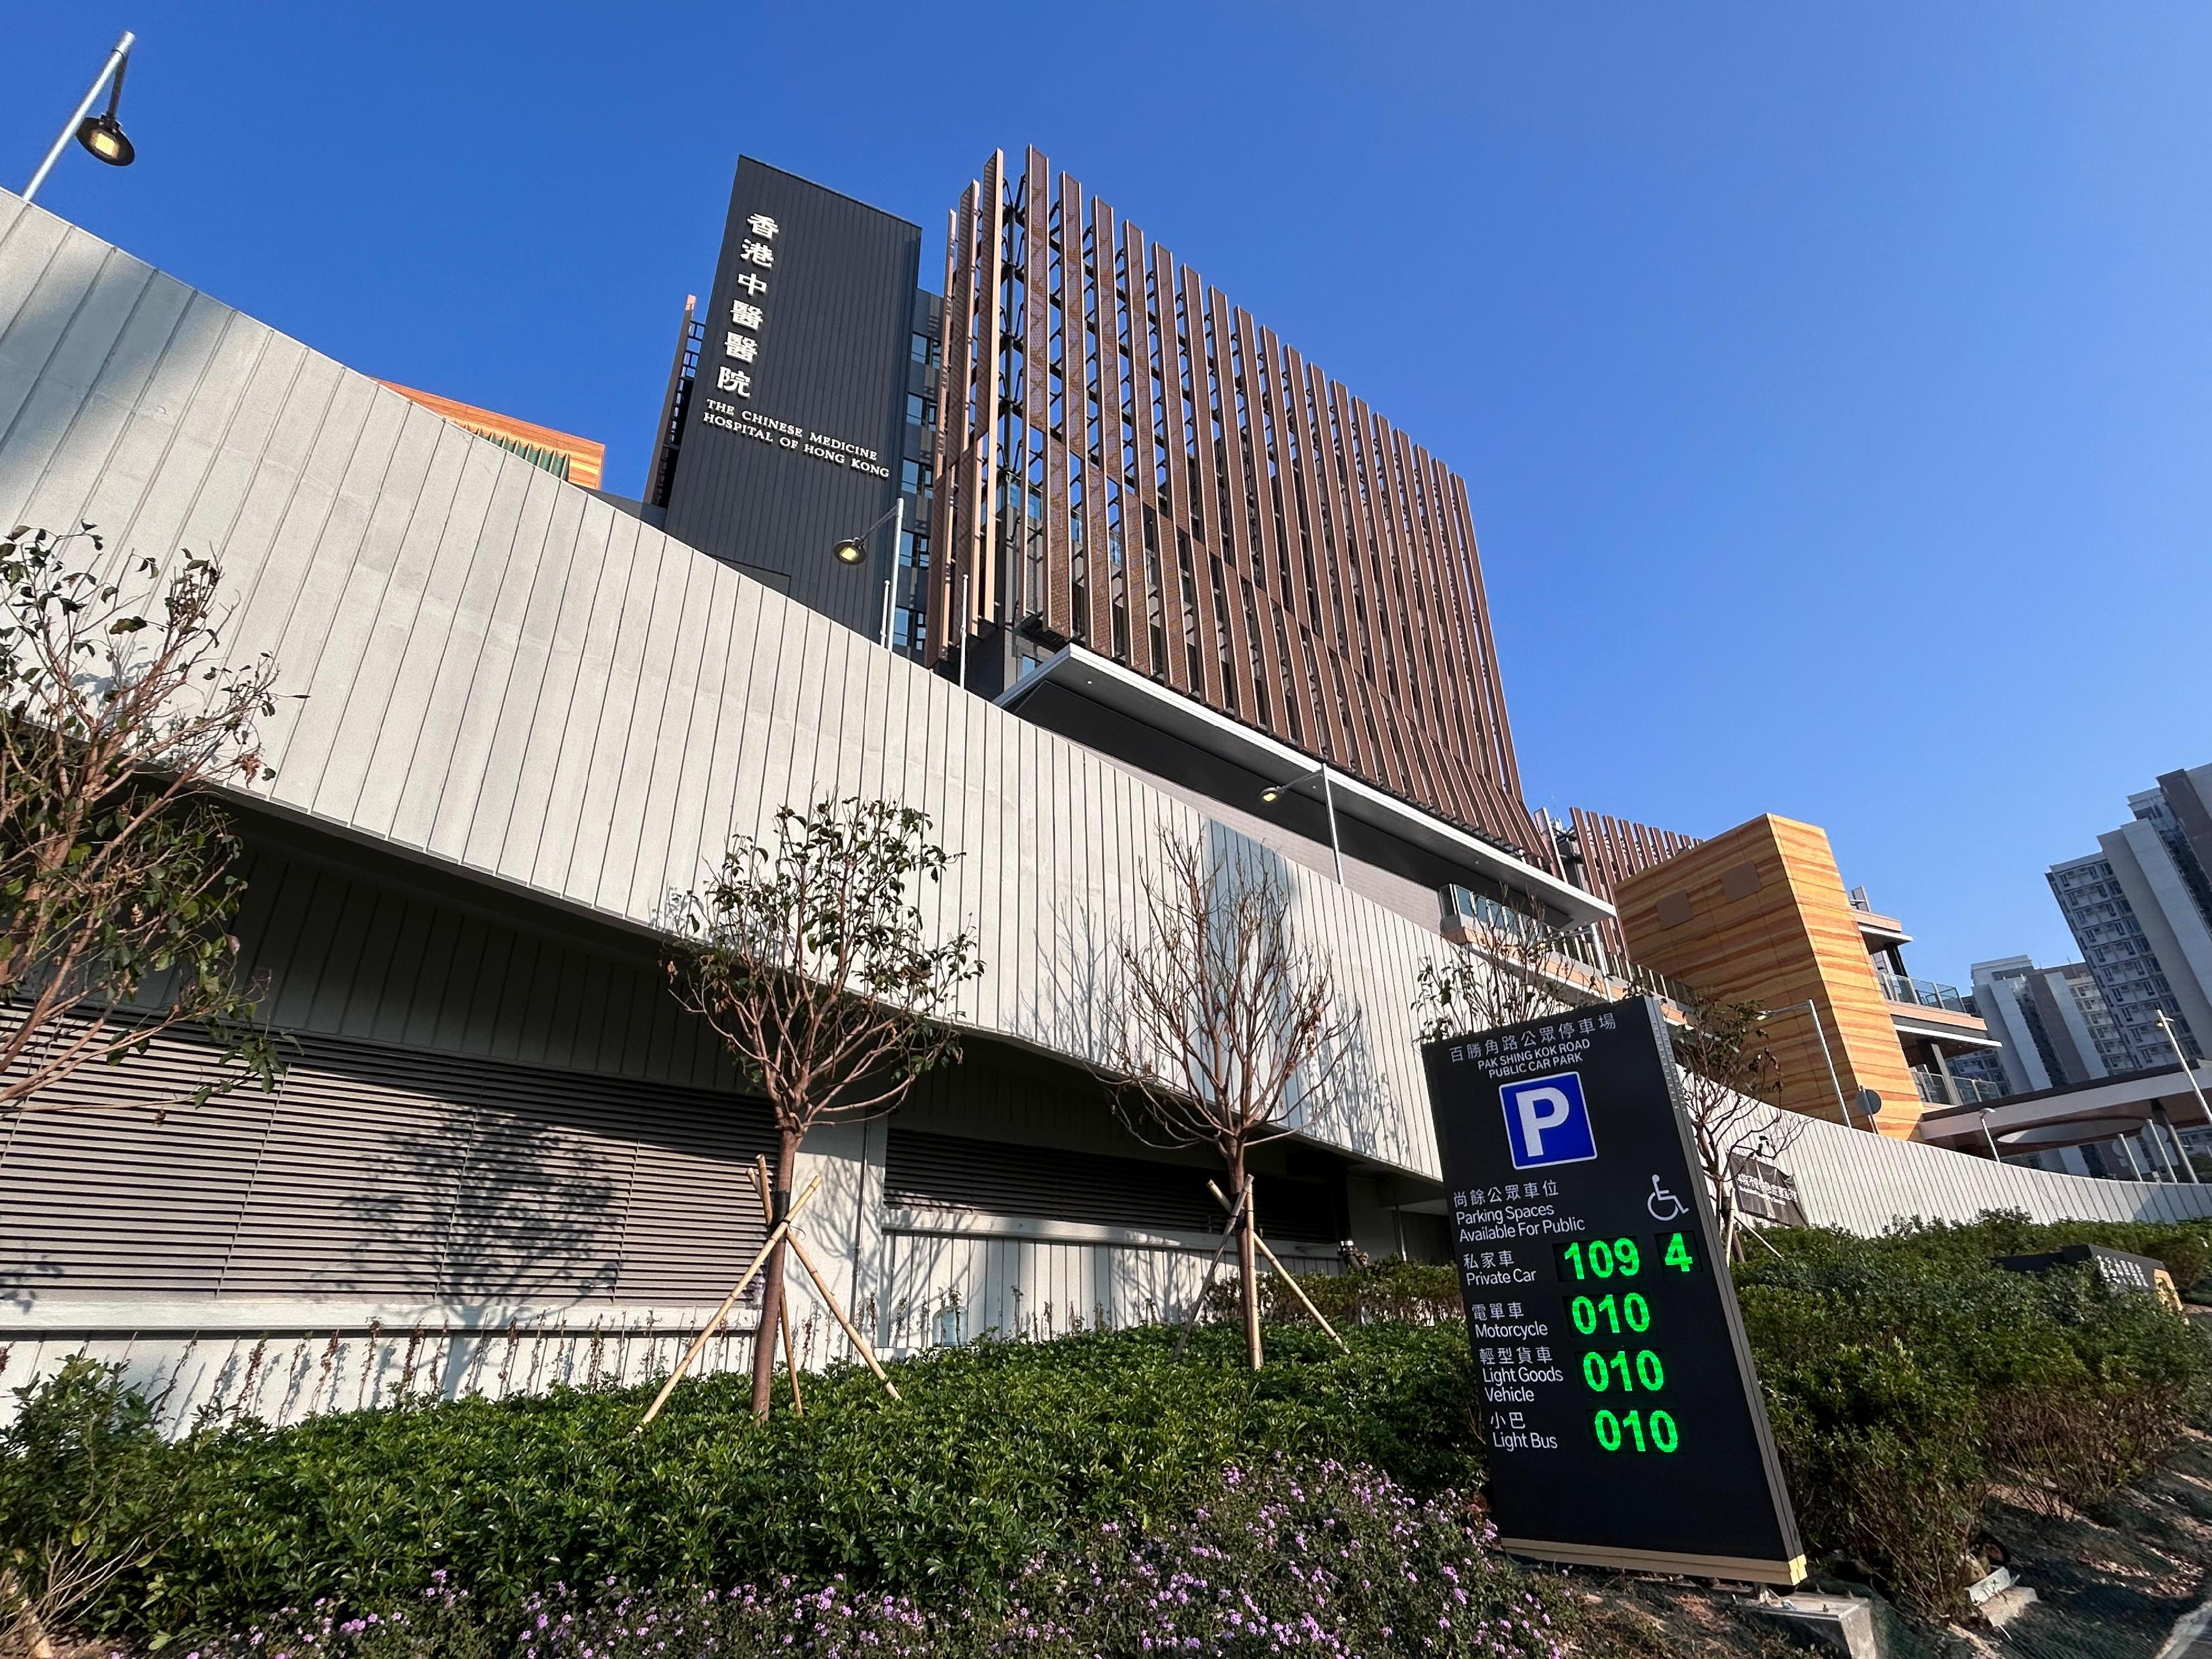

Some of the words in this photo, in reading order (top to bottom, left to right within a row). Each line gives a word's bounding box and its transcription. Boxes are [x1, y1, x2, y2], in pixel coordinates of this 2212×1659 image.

[717, 213, 779, 398] 香港中醫醫院
[707, 398, 735, 415] THE
[742, 411, 802, 437] CHINESE
[810, 432, 877, 461] MEDICINE
[703, 413, 773, 442] HOSPITAL
[780, 437, 799, 449] OF
[804, 444, 844, 463] HONG
[851, 458, 889, 477] KONG
[1449, 1013, 1616, 1062] 百勝角路公眾停車場
[1478, 1058, 1498, 1070] PAK
[1501, 1051, 1532, 1066] SHING
[1535, 1045, 1557, 1058] KOK
[1558, 1039, 1590, 1053] ROAD
[1489, 1063, 1527, 1078] PUBLIC
[1528, 1059, 1551, 1071] CAR
[1553, 1052, 1583, 1066] PARK
[1515, 1087, 1569, 1157] P
[1453, 1179, 1558, 1208] 尚餘公眾車位
[1456, 1209, 1503, 1225] Parking
[1505, 1204, 1554, 1222] Spaces
[1459, 1224, 1515, 1242] Available
[1517, 1222, 1540, 1236] For
[1542, 1217, 1585, 1234] Public
[1463, 1250, 1514, 1270] 私家車
[1564, 1238, 1639, 1280] 109
[1665, 1233, 1693, 1271] 4
[1466, 1271, 1511, 1286] Private
[1513, 1269, 1536, 1282] Car
[1472, 1302, 1524, 1321] 電單車
[1572, 1293, 1650, 1334] 010
[1475, 1321, 1548, 1340] Motorcycle
[1479, 1346, 1553, 1365] 輕型貨車
[1483, 1367, 1517, 1386] Light
[1519, 1366, 1564, 1382] Goods
[1583, 1350, 1663, 1391] 010
[1484, 1386, 1535, 1402] Vehicle
[1490, 1411, 1525, 1429] 小巴
[1595, 1410, 1678, 1453] 010
[1493, 1432, 1528, 1452] Light
[1530, 1433, 1558, 1449] Bus
